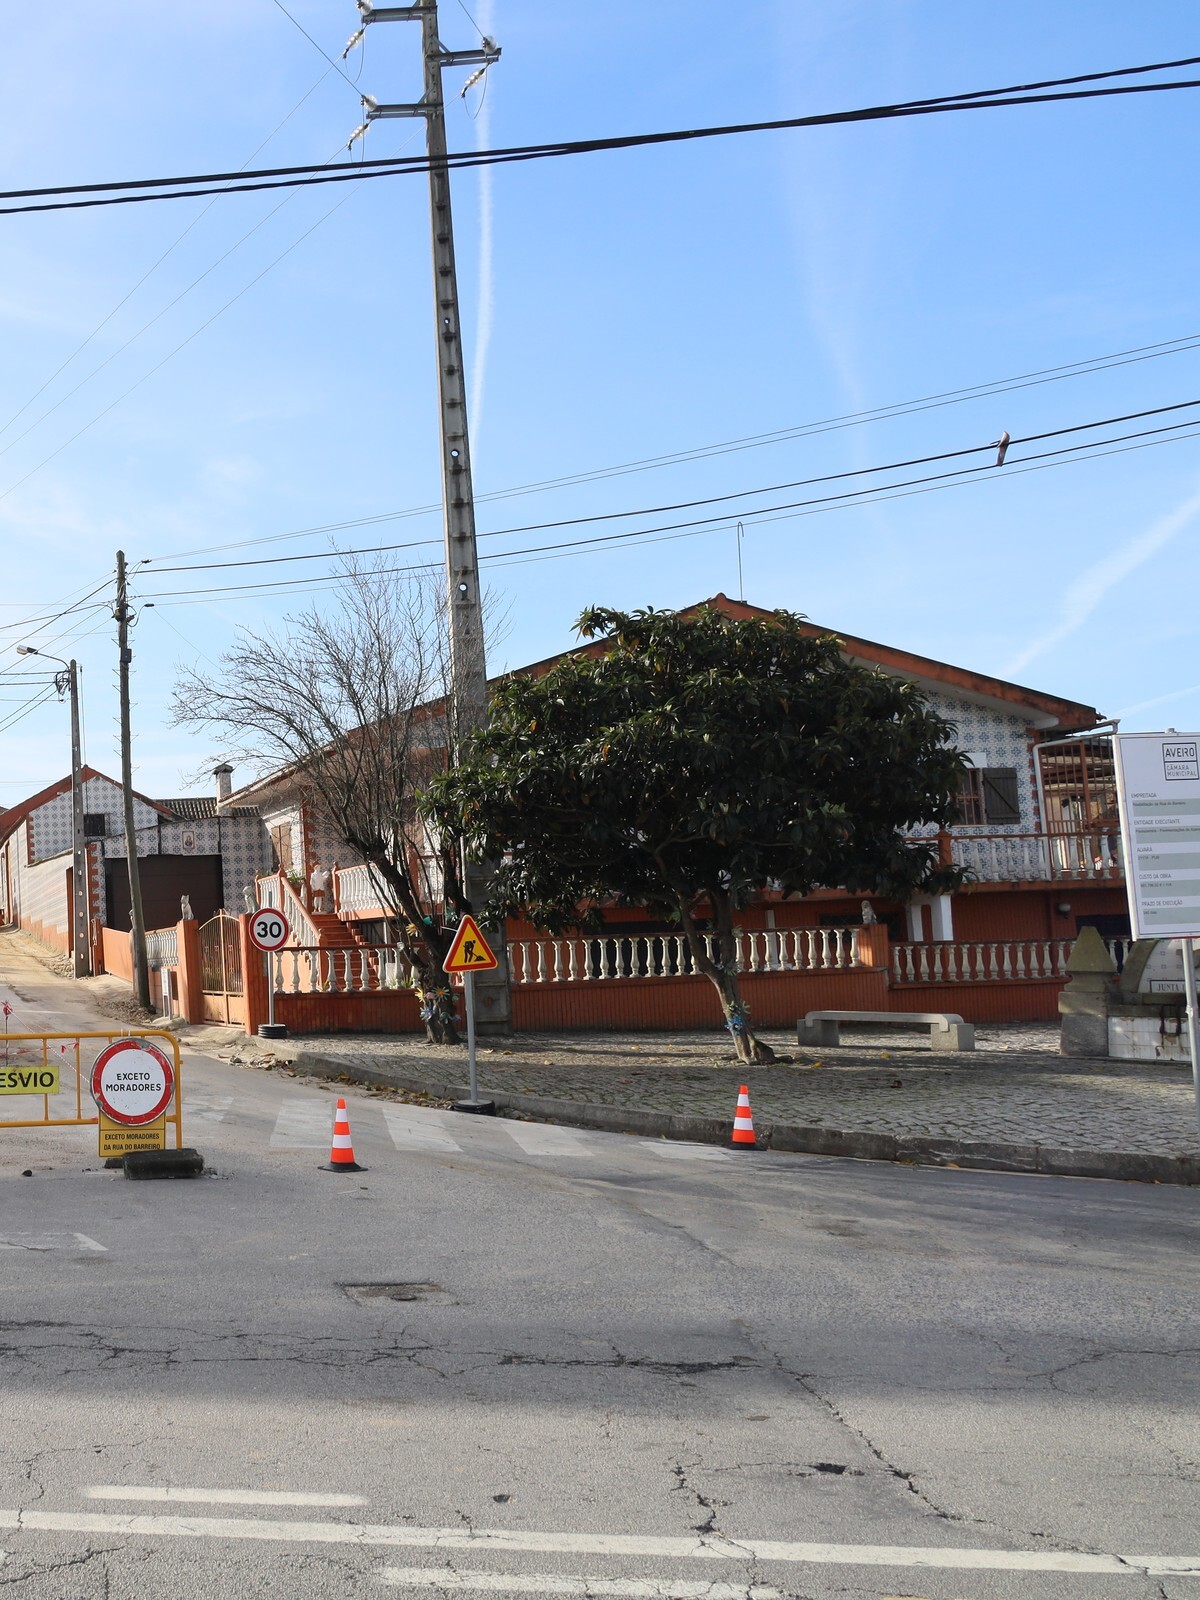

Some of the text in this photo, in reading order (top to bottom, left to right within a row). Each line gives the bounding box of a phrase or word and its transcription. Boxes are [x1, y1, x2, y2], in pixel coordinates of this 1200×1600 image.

[1165, 747, 1195, 758] AVEIRO
[257, 921, 282, 938] 30
[1157, 983, 1179, 992] JUNTA
[116, 1072, 151, 1081] EXCETO
[105, 1083, 162, 1092] MORADORES
[104, 1132, 160, 1141] EXCETO MORADORES
[112, 1143, 123, 1151] RUA
